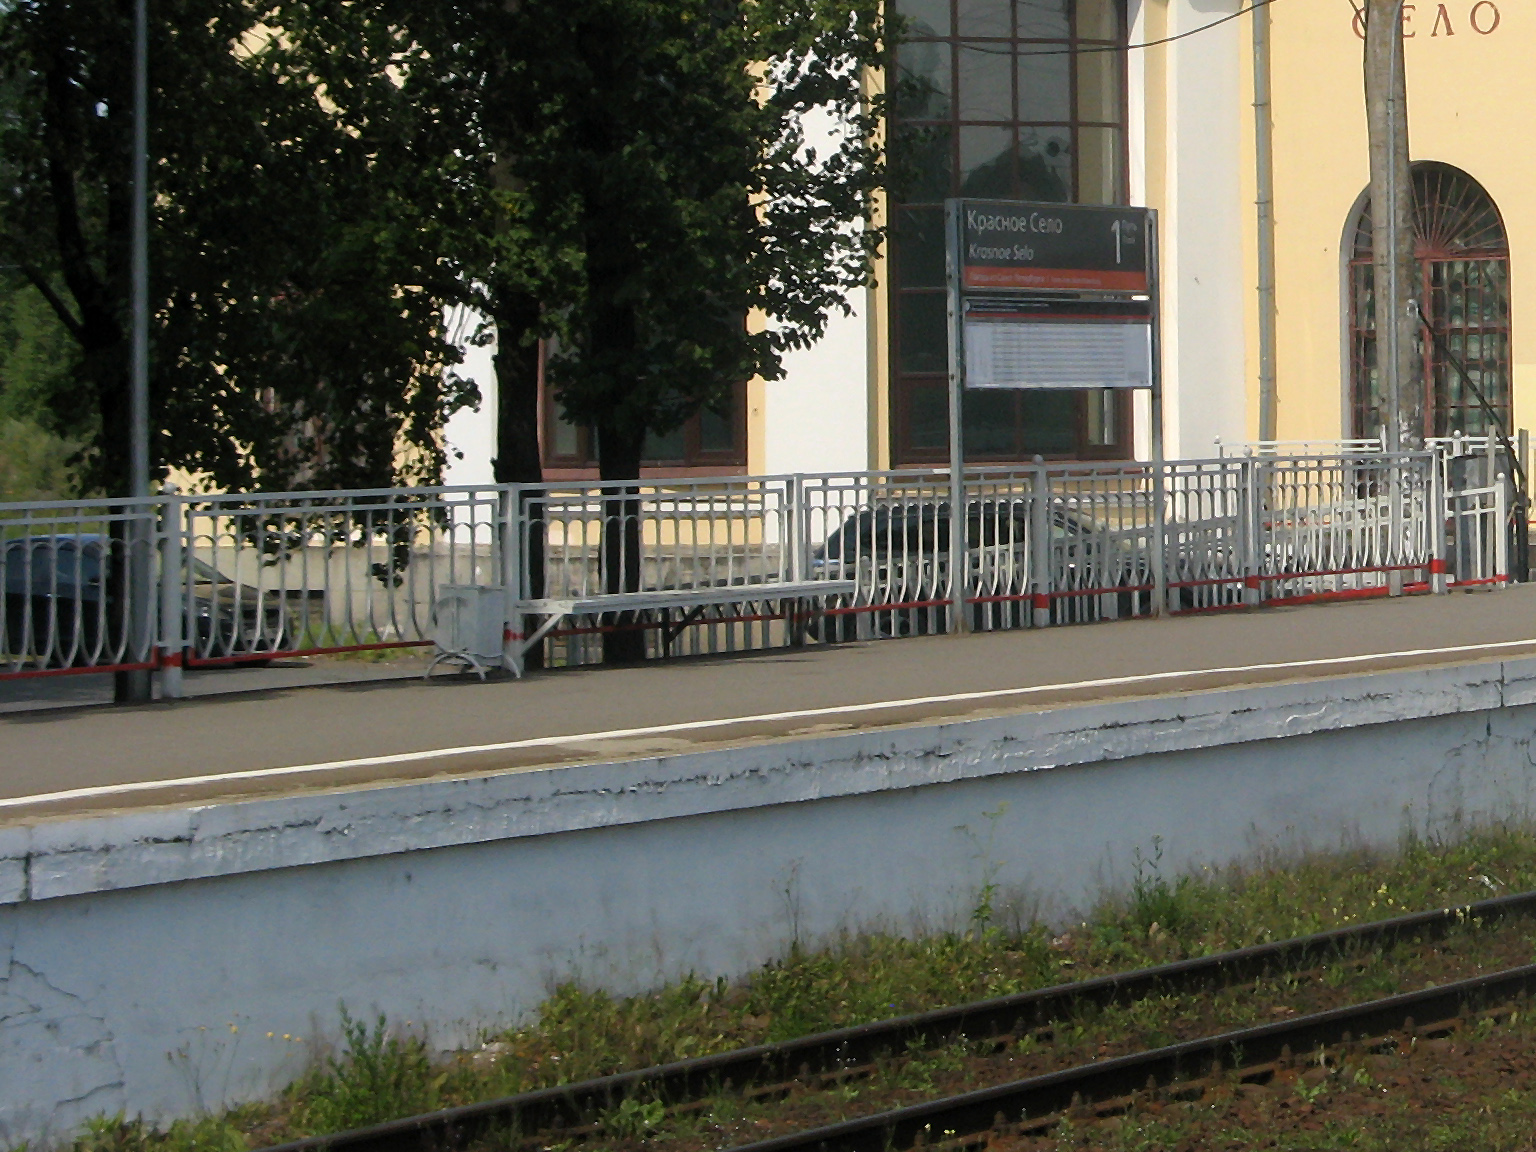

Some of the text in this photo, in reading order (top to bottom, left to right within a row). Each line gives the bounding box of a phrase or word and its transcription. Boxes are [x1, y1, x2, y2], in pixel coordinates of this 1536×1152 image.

[967, 210, 1063, 235] Красное Село
[968, 242, 1034, 261] Krasnoe Selo
[1111, 219, 1121, 264] 1
